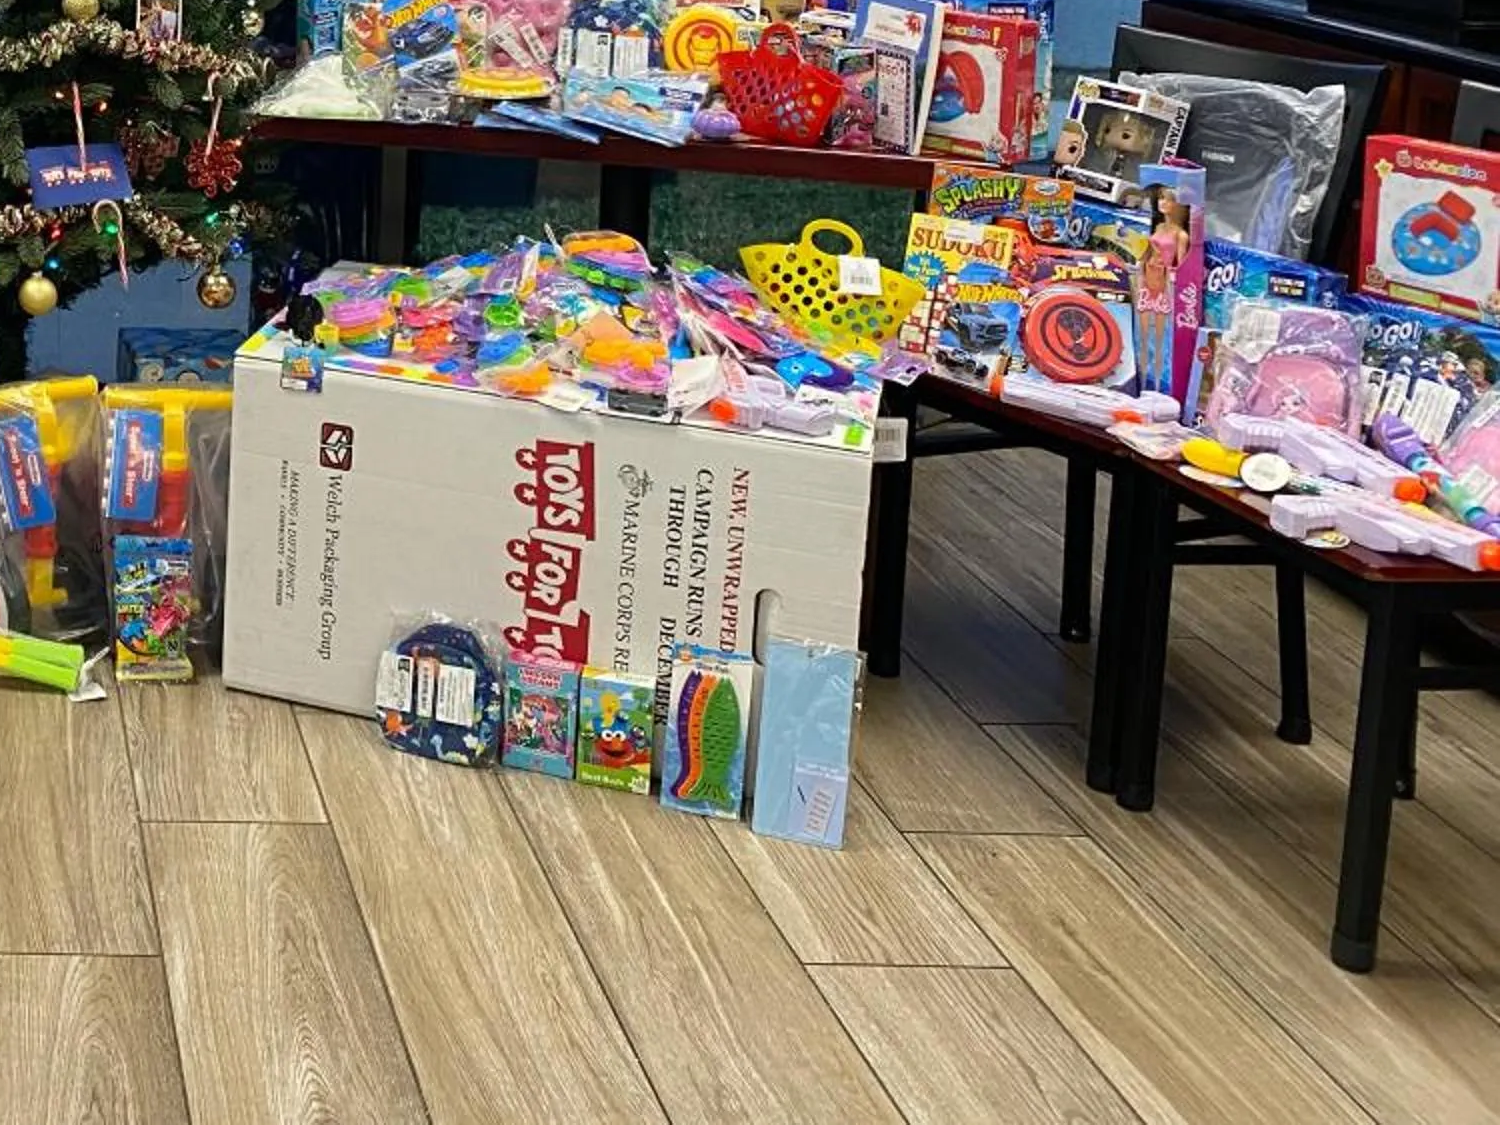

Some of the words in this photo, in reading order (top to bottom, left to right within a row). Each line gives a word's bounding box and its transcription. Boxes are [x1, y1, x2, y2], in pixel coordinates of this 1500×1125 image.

[934, 177, 1021, 214] SPLASHY
[1137, 288, 1172, 314] Barbie
[1176, 282, 1199, 330] Barbie
[326, 475, 343, 524] Welch
[542, 448, 585, 527] TOYS
[620, 501, 640, 579] MARINE
[663, 485, 686, 588] THROUGH
[689, 469, 714, 581] CAMPAIGN
[319, 529, 340, 608] Packaging
[534, 543, 573, 607] FOR
[719, 527, 745, 653] UNWRAPPED
[317, 612, 337, 661] Group
[615, 582, 635, 643] CORPS
[685, 584, 705, 638] RUNS
[653, 617, 677, 727] DECEMBER
